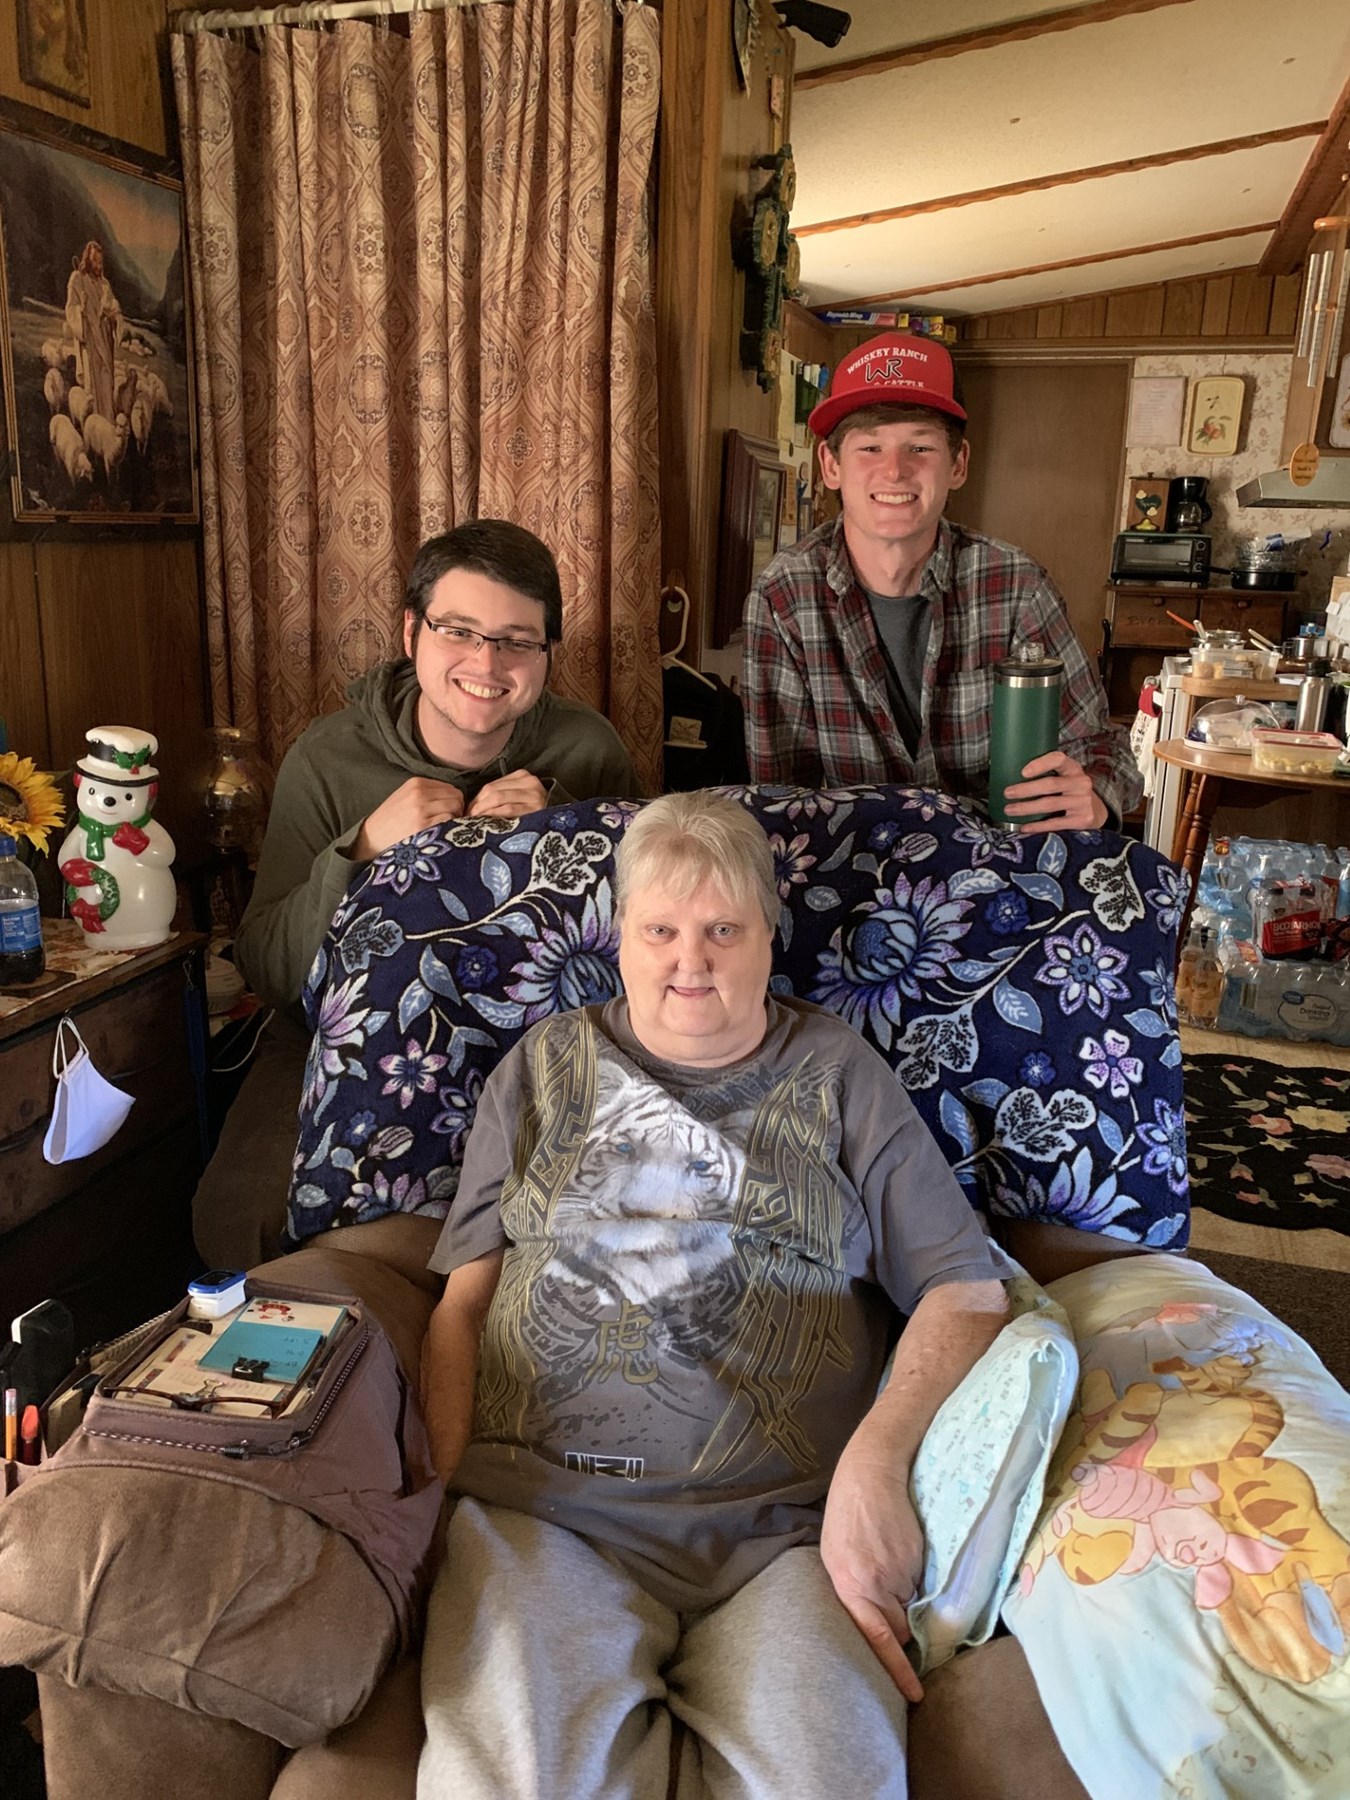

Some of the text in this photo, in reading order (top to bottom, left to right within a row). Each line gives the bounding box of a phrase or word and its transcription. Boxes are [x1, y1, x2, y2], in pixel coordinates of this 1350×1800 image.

[847, 347, 928, 374] WHISKEY RANCH
[582, 1298, 660, 1385] 虎
